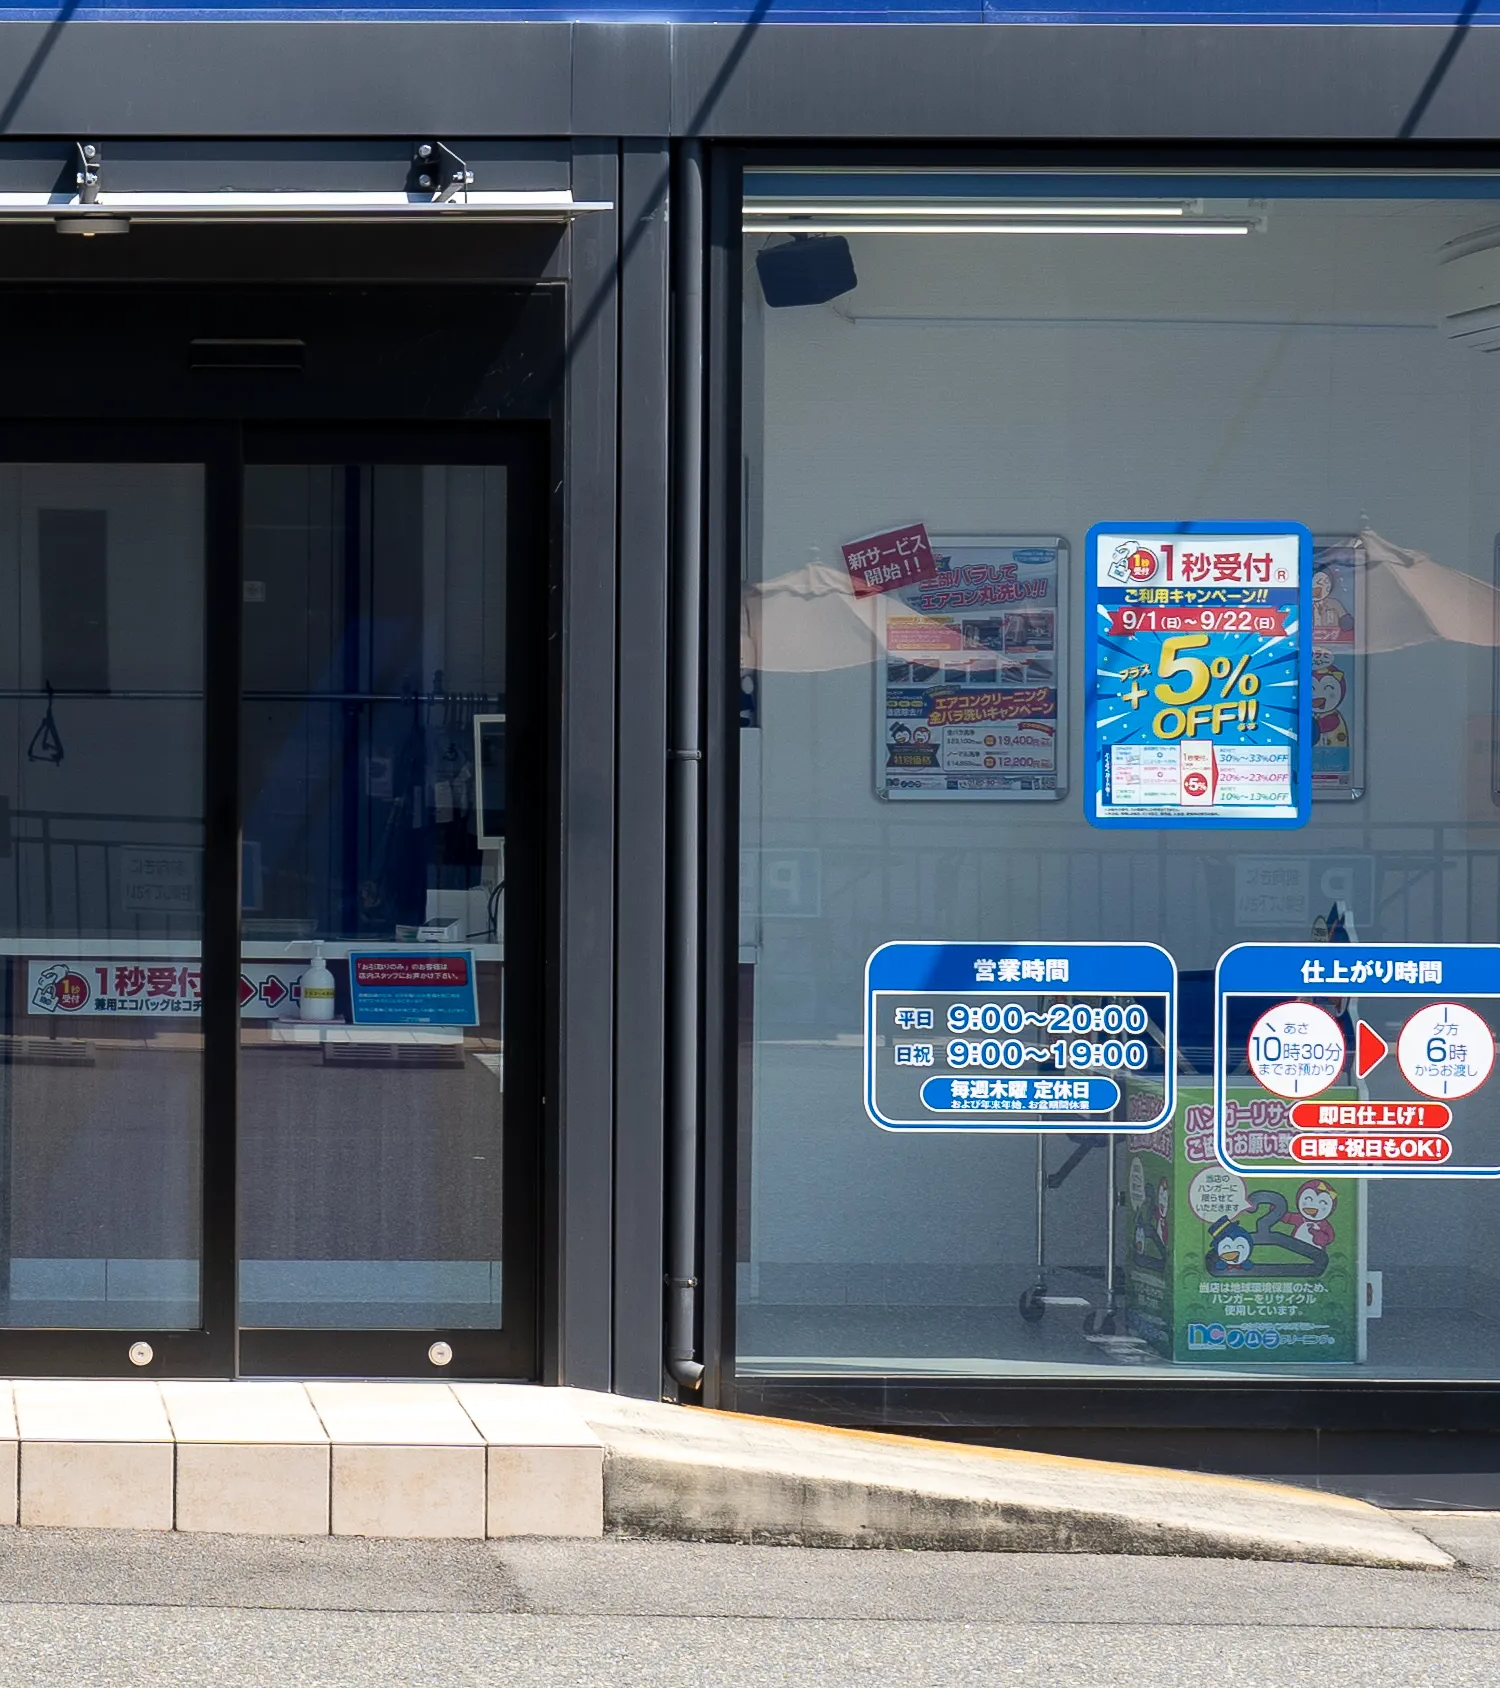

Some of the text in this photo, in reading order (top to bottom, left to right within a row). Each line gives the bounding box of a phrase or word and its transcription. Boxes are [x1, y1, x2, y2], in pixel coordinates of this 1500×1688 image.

[848, 534, 927, 570] 新サービス
[1161, 544, 1273, 582] 1秒受付
[1124, 589, 1268, 604] ご利用キャンペーン!!
[1119, 663, 1152, 681] プラス
[1153, 700, 1259, 739] OFF!!
[973, 958, 1070, 983] 営業時間
[1301, 959, 1443, 984] 仕上がり時間
[896, 1009, 932, 1029] 平日
[1284, 1023, 1309, 1035] あさ
[1434, 1023, 1458, 1036] 夕方
[895, 1045, 932, 1066] 日祝
[1252, 1035, 1342, 1063] 10時30分
[1426, 1036, 1467, 1062] 6時
[1258, 1063, 1335, 1077] までお預かり
[1415, 1063, 1478, 1077] からお渡し
[951, 1079, 1089, 1100] 毎週木曜 定休日
[1318, 1106, 1426, 1126] 即日仕上げ!
[1198, 1184, 1238, 1193] ハンガーに
[1206, 1174, 1230, 1183] 当店の
[1196, 1203, 1239, 1212] いただきます
